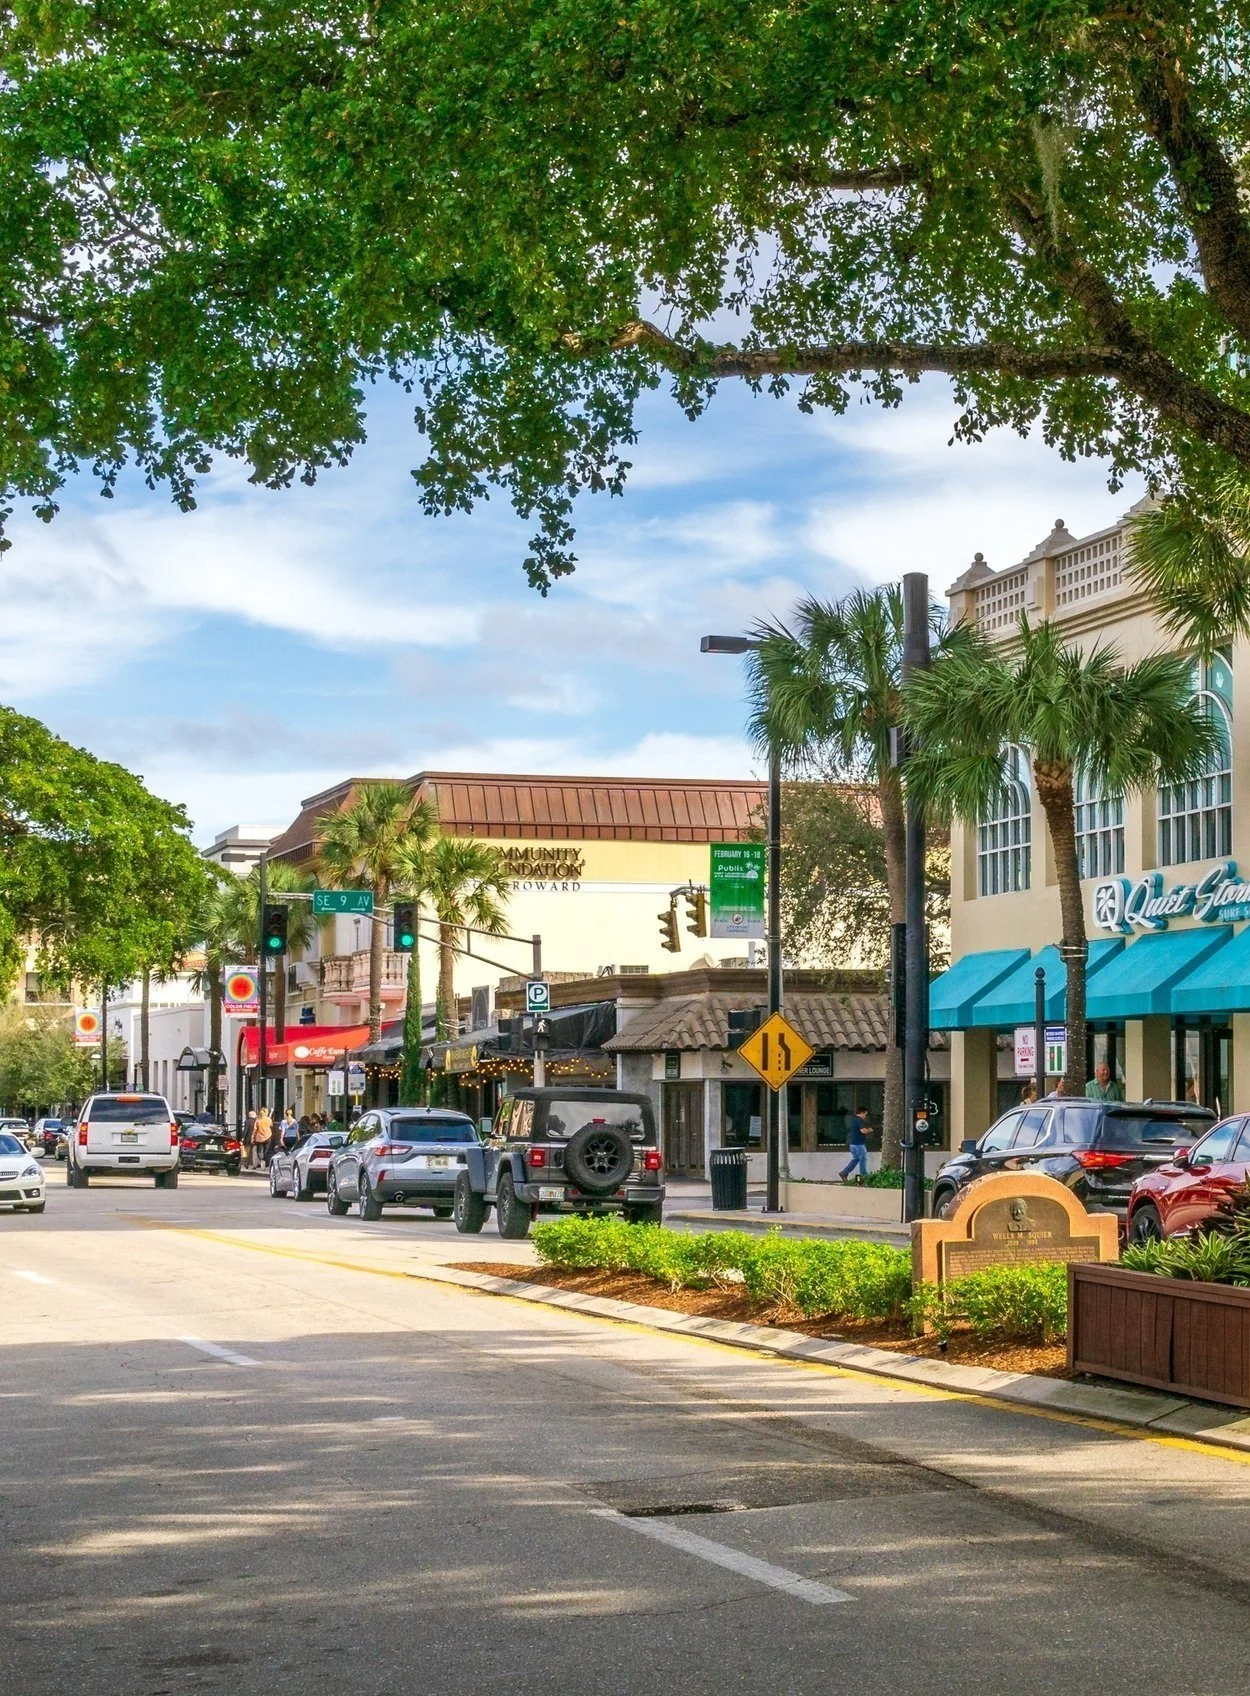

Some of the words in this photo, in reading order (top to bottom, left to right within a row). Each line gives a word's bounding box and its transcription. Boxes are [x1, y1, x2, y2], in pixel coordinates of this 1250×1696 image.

[714, 850, 742, 858] FEBRUARY
[717, 864, 744, 872] Publix
[512, 881, 581, 891] ROWARD
[316, 894, 331, 907] SE
[340, 895, 348, 906] 9
[357, 895, 370, 907] AV
[1124, 874, 1193, 929] Quiet
[1218, 908, 1241, 920] SURF
[1022, 1035, 1029, 1045] NO
[1017, 1046, 1034, 1057] PARKING
[992, 1232, 1015, 1240] WELLS
[1027, 1231, 1053, 1240] SQUIER
